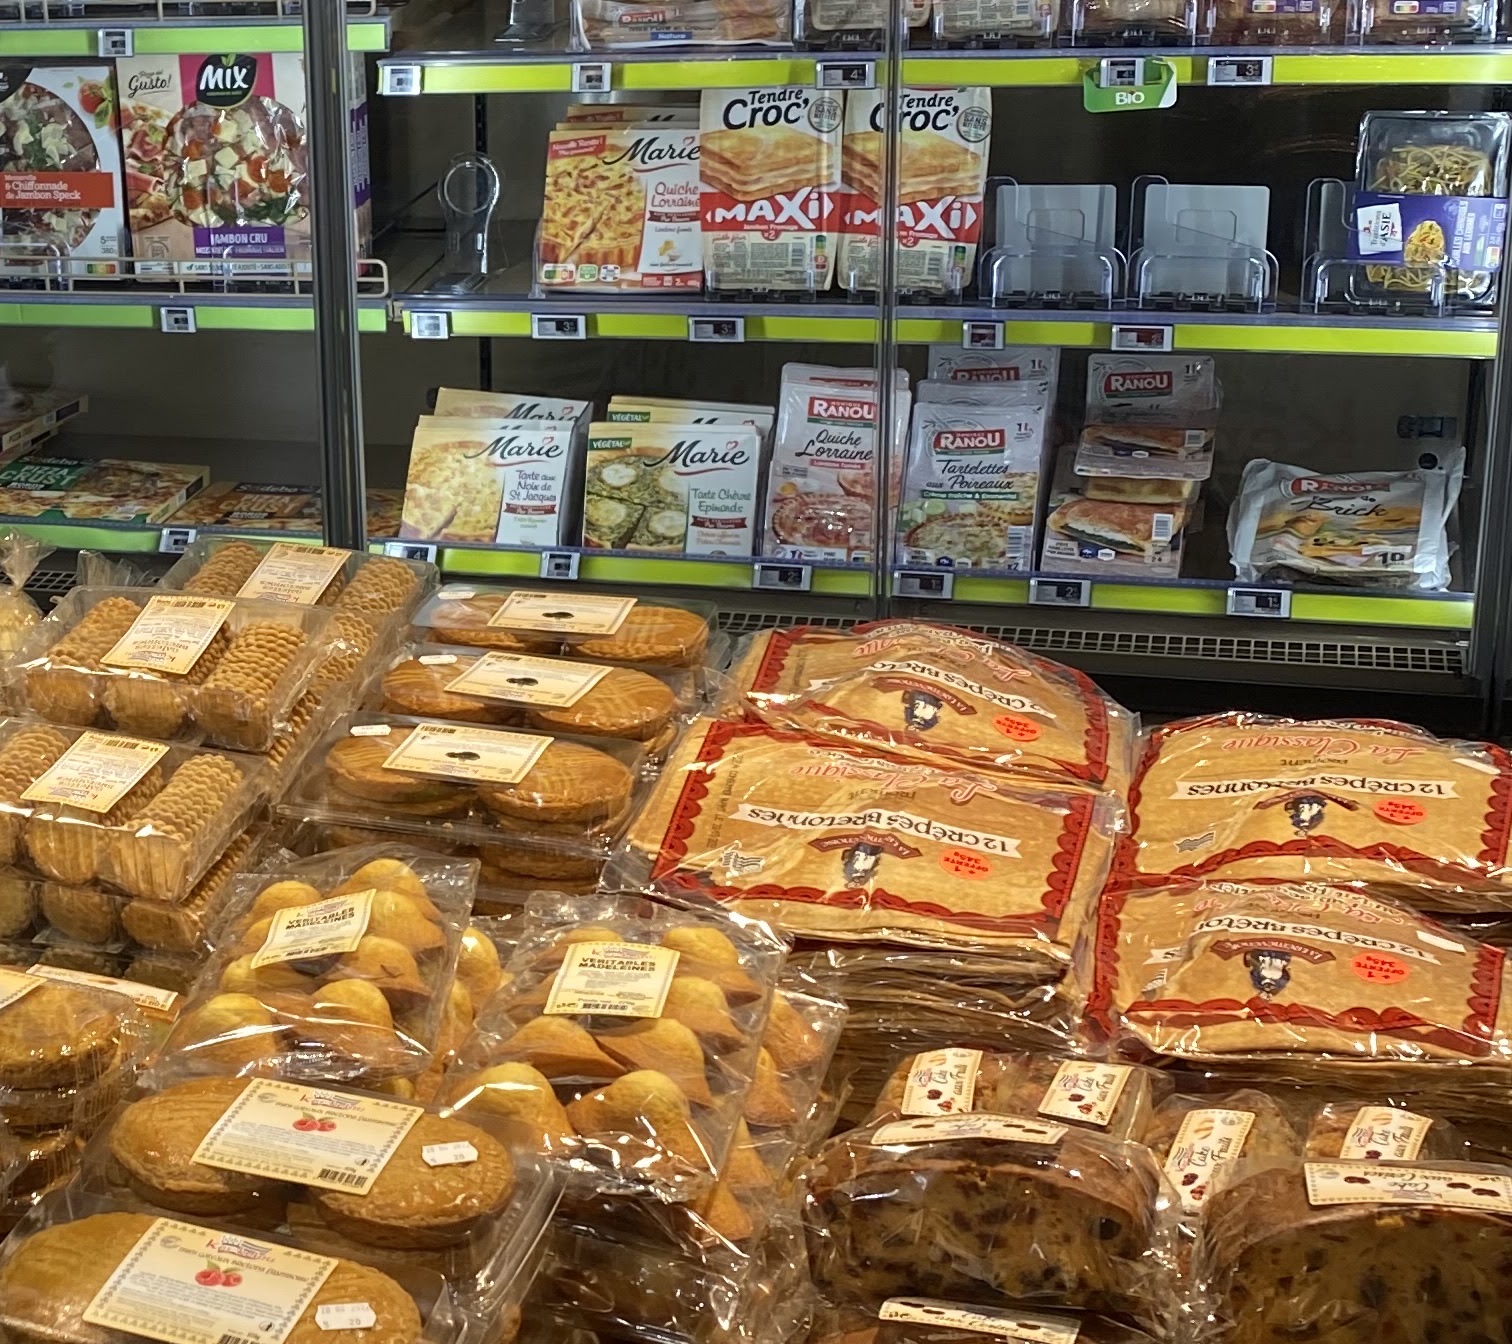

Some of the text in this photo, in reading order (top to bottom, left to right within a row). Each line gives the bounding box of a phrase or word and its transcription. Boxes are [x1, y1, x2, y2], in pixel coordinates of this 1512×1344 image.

[127, 74, 173, 100] Gusto!
[199, 63, 250, 92] MIX
[747, 88, 805, 106] Tendre
[602, 137, 700, 166] Marie
[15, 190, 82, 202] Jambon Speck
[654, 180, 699, 199] Quiche
[249, 232, 269, 244] CRU
[1109, 373, 1170, 393] RANOU
[812, 399, 875, 420] RANOU
[815, 428, 863, 446] Quiche
[939, 432, 1002, 450] RANOU
[462, 435, 564, 460] Marie
[643, 440, 750, 468] Marie
[794, 439, 874, 462] Lorraine
[935, 458, 1011, 476] Tartelettes
[947, 474, 1016, 491] Poireaux
[690, 488, 717, 500] Tarte
